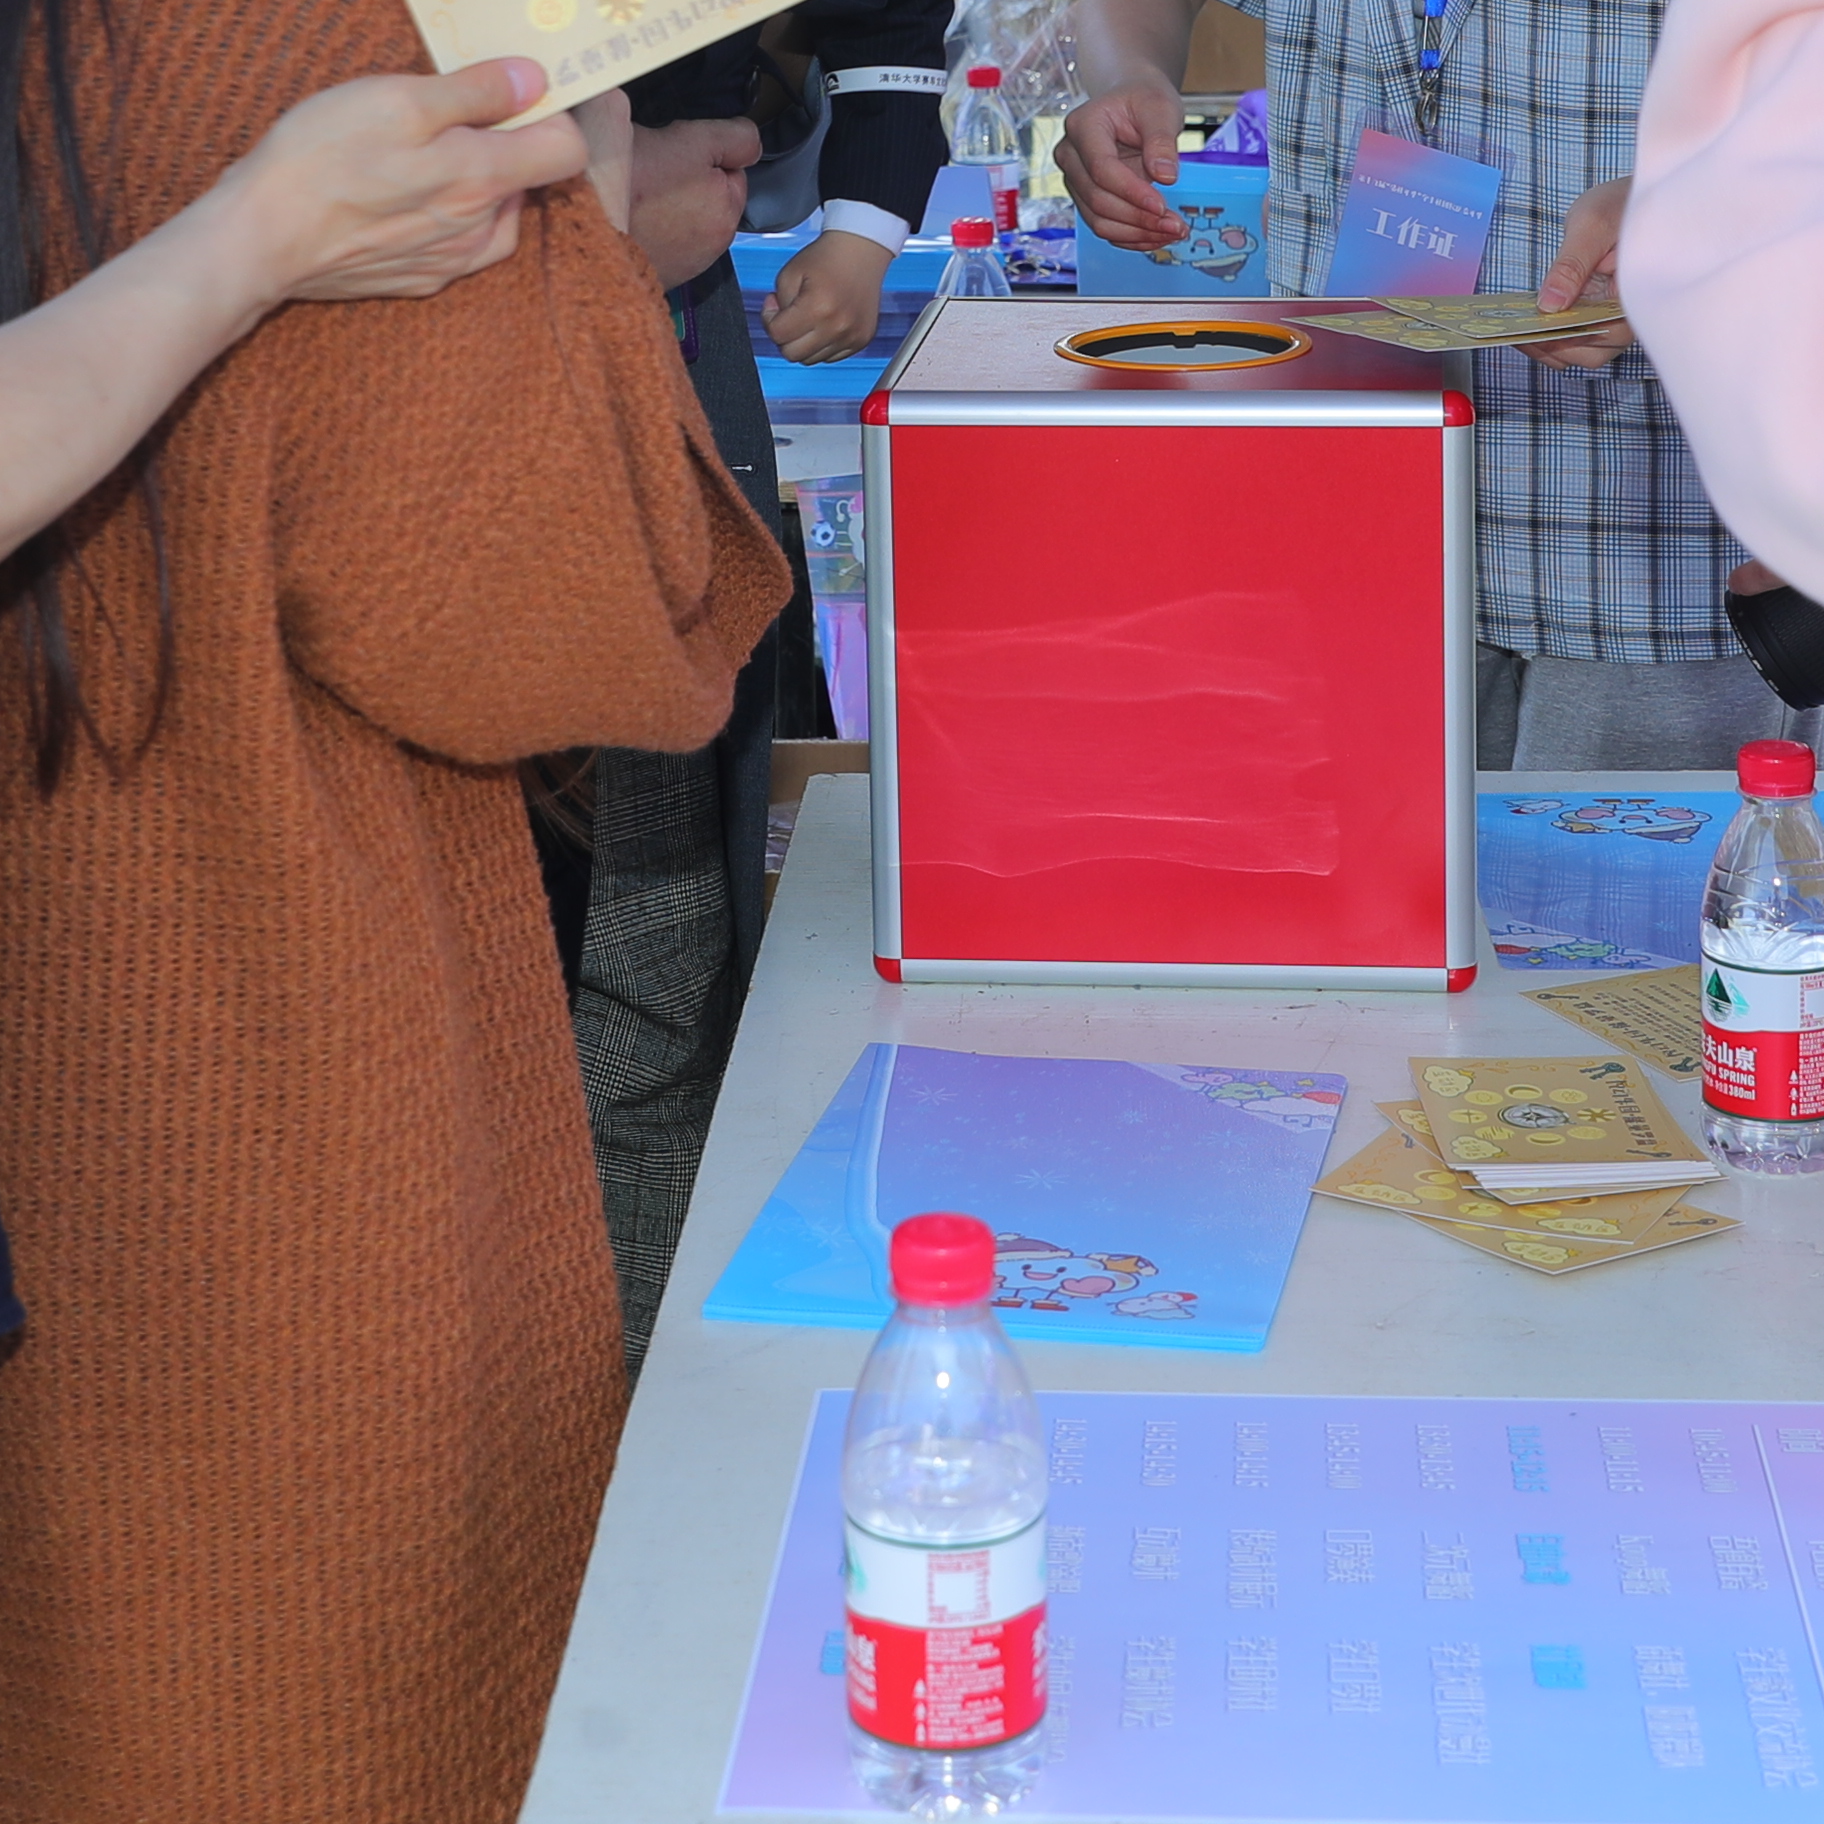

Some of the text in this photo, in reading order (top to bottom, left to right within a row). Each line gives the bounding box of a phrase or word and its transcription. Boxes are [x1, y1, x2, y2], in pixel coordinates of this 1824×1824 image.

[1366, 207, 1459, 260] 工作证
[1718, 1066, 1756, 1087] SPRING
[1598, 1426, 1645, 1492] 11:00-11:15
